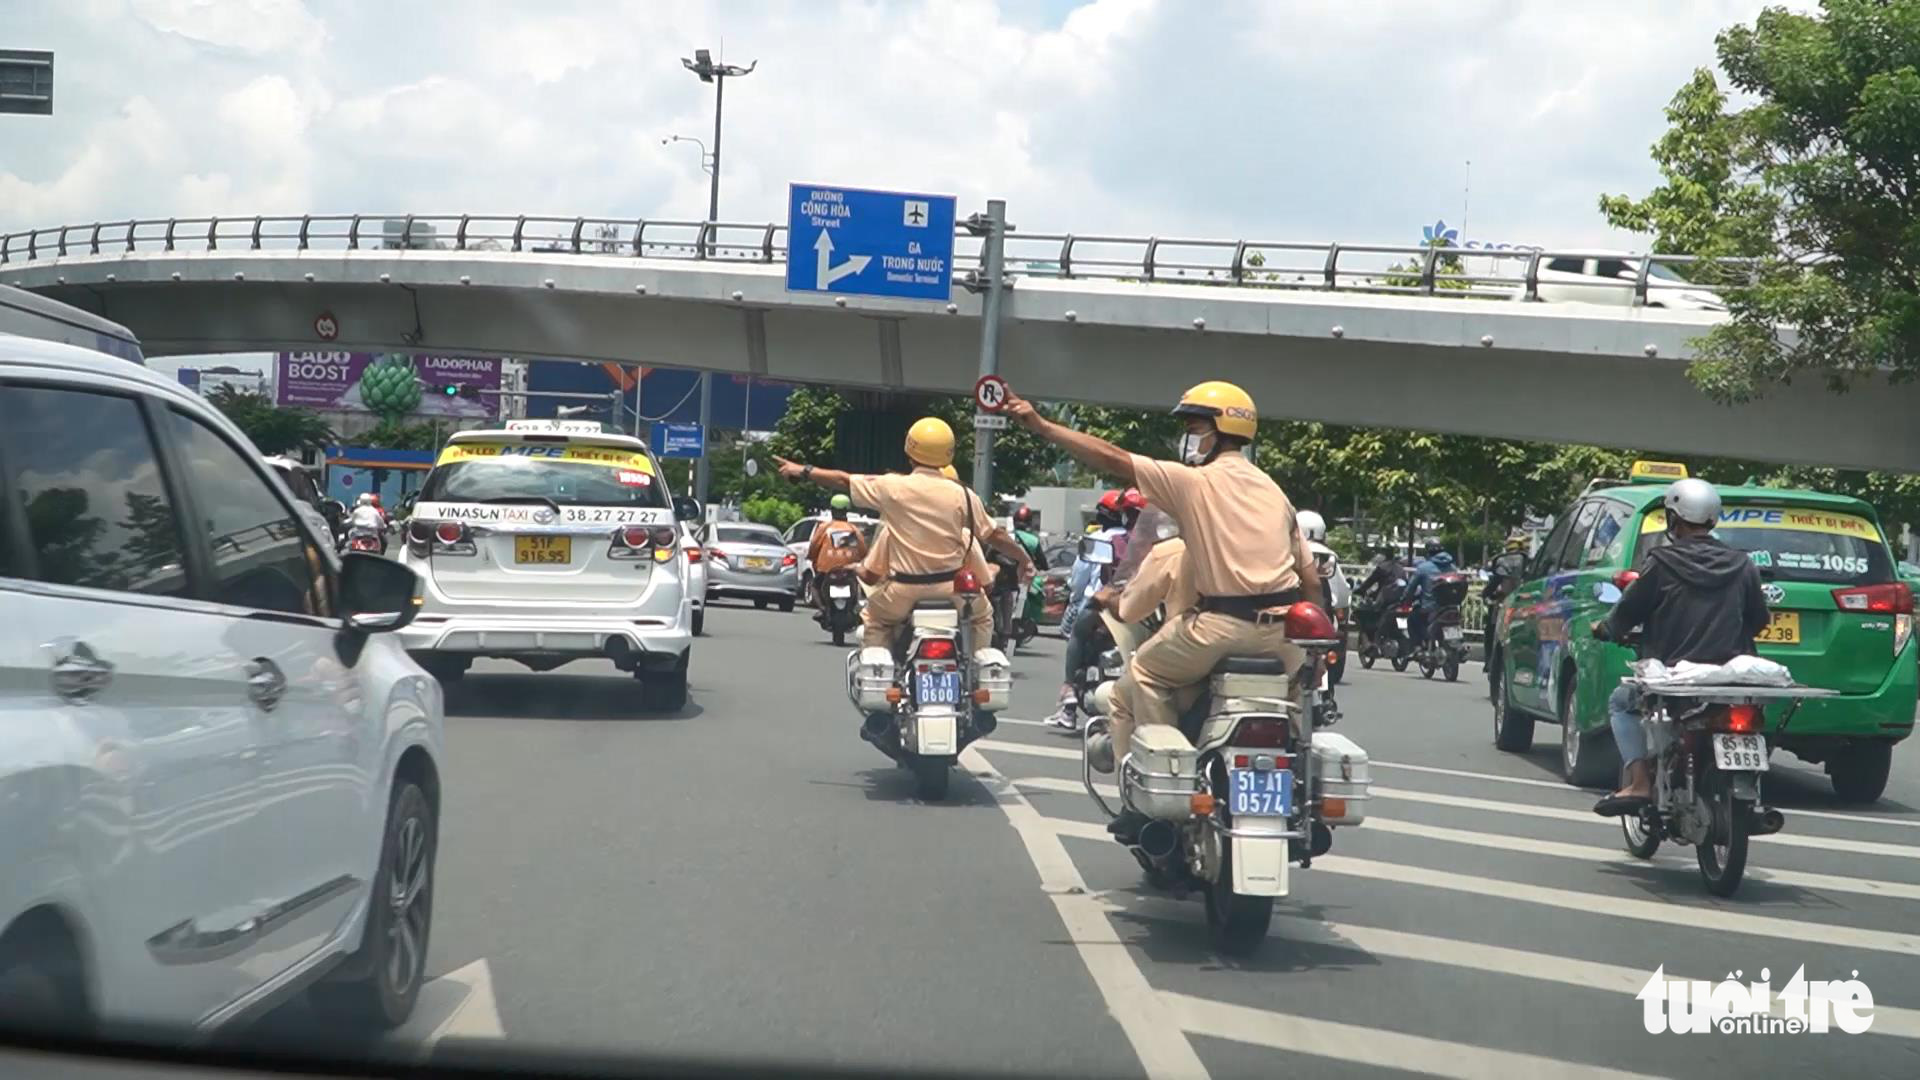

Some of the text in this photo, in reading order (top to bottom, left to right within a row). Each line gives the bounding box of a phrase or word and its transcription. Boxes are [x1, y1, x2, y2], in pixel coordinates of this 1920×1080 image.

[801, 200, 851, 218] CỘNG HÒA
[811, 216, 840, 228] Street
[908, 241, 921, 254] GA
[882, 256, 944, 272] TRONG NƯỚC
[289, 363, 350, 380] BOOST
[425, 356, 493, 372] LADOPHAR
[502, 509, 528, 520] TAXI
[617, 510, 634, 522] 27
[639, 512, 657, 523] 27
[1717, 509, 1785, 525] MPE
[1822, 554, 1869, 573] 1055
[921, 688, 954, 702] 0600
[1724, 752, 1760, 767] 5869
[1238, 792, 1284, 813] 0574
